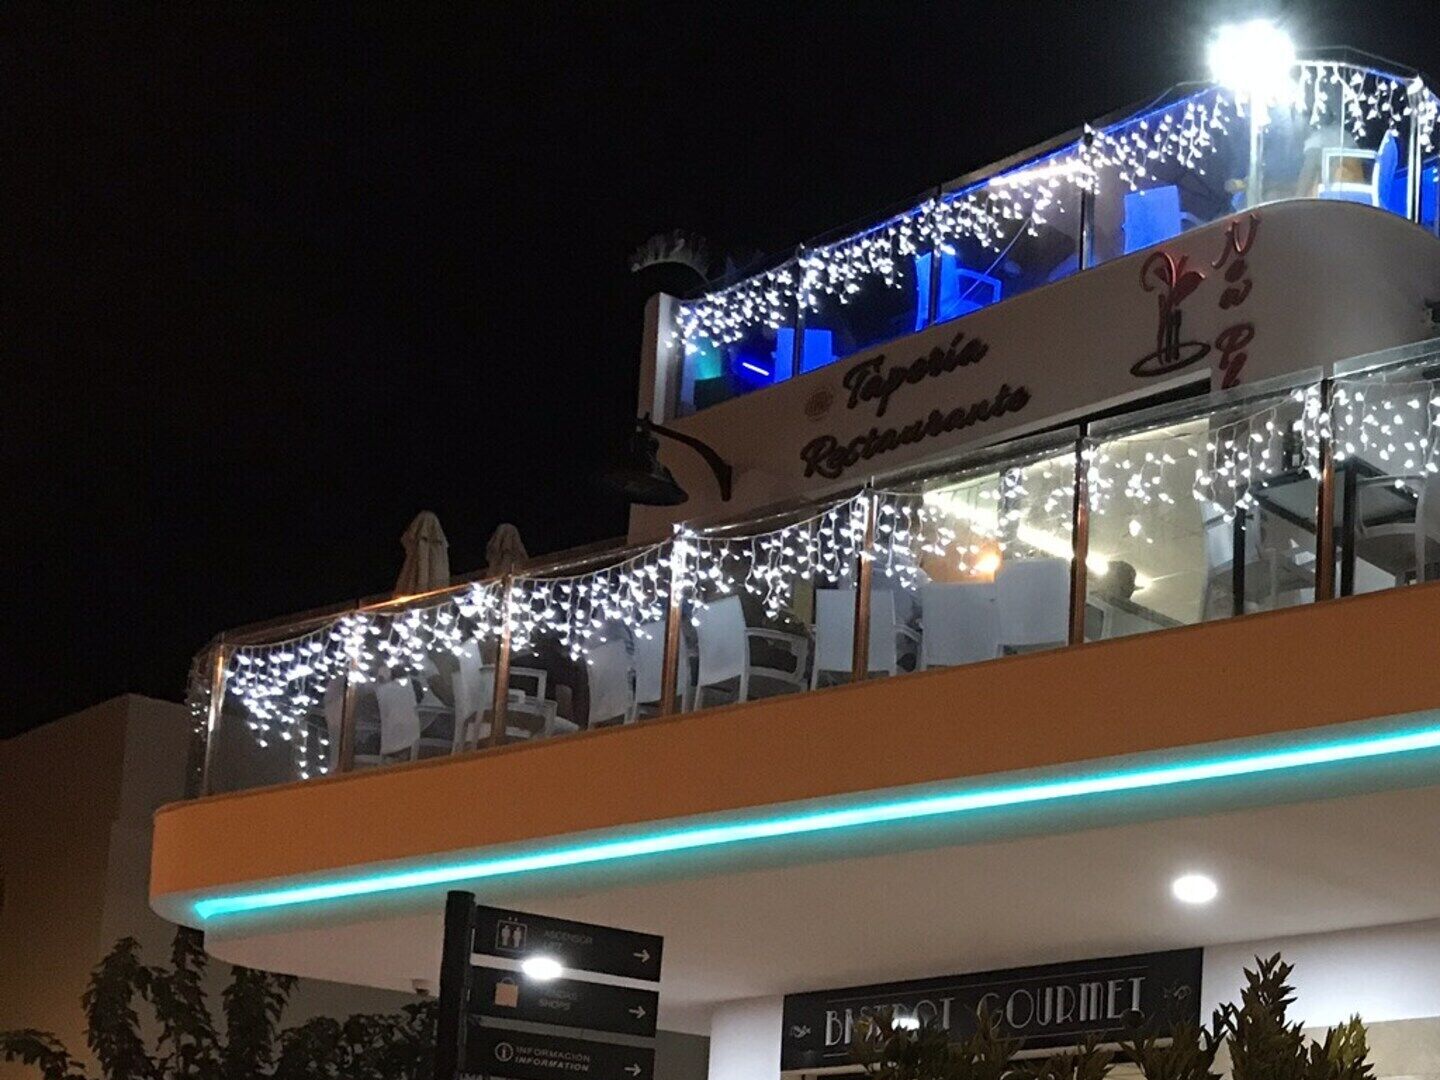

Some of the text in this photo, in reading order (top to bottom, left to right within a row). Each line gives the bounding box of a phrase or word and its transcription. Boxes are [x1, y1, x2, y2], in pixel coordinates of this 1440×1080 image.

[800, 383, 1032, 479] Restaurante
[976, 976, 1147, 1032] GOURMET
[513, 1055, 590, 1073] INFORMATION
